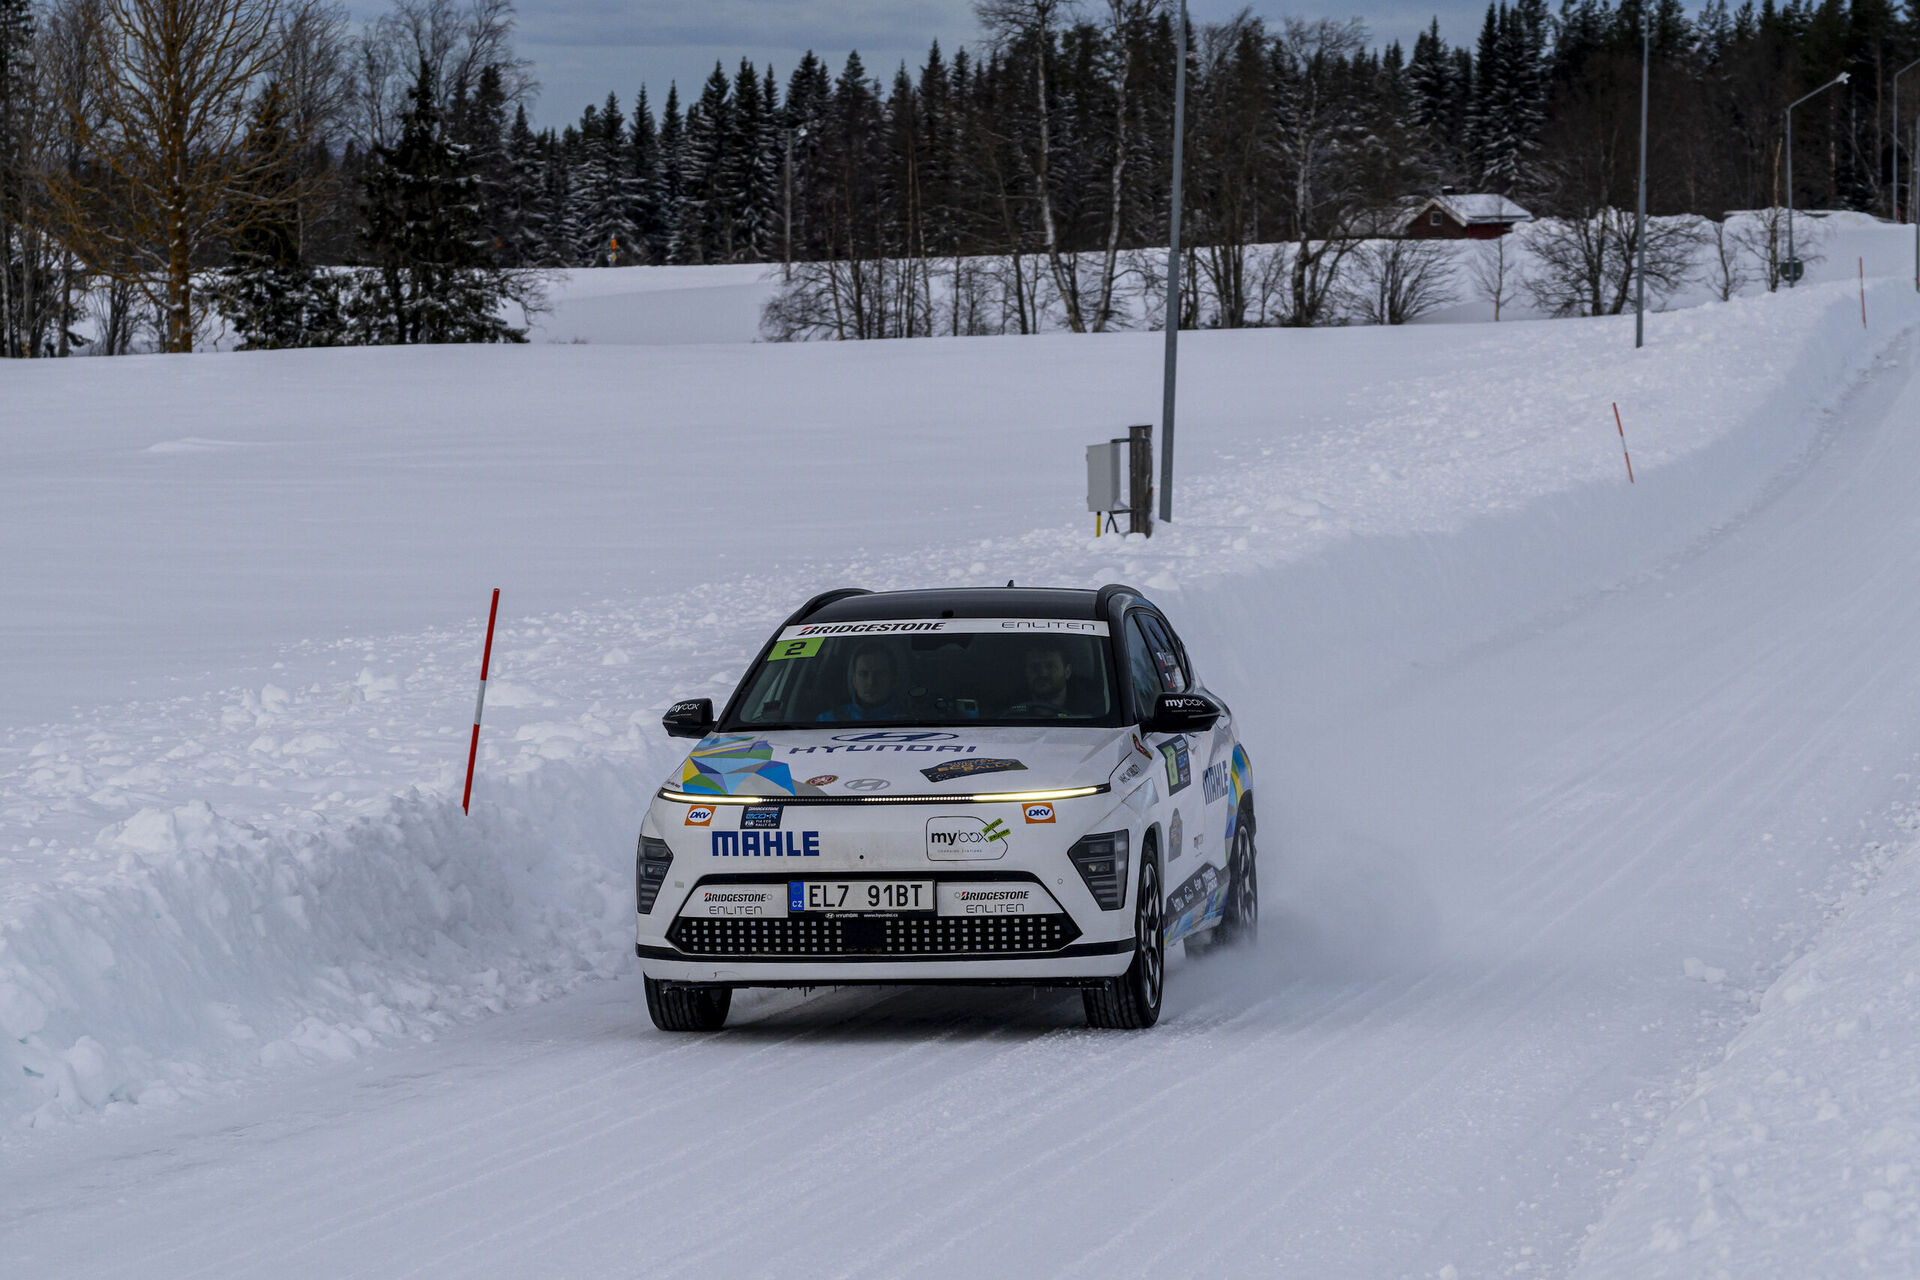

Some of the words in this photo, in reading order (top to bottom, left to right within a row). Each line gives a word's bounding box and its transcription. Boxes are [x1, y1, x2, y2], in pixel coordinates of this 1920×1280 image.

[798, 622, 946, 636] BRIDGESTONE
[1001, 621, 1096, 631] ENLITEN
[784, 642, 807, 656] 2
[1164, 698, 1206, 708] mybox
[789, 744, 977, 755] HYUNDAI
[1202, 760, 1229, 806] MAHLE
[689, 811, 711, 819] DKV
[1028, 808, 1050, 817] DKV
[931, 830, 989, 846] mybox
[712, 831, 819, 856] MAHLE
[704, 893, 767, 902] BRIDGESTONE
[809, 885, 849, 908] EL7
[867, 884, 923, 907] 91BT
[960, 891, 1030, 901] BRIDGESTONE
[709, 906, 763, 915] ENLITEN
[966, 904, 1025, 914] ENLITEN
